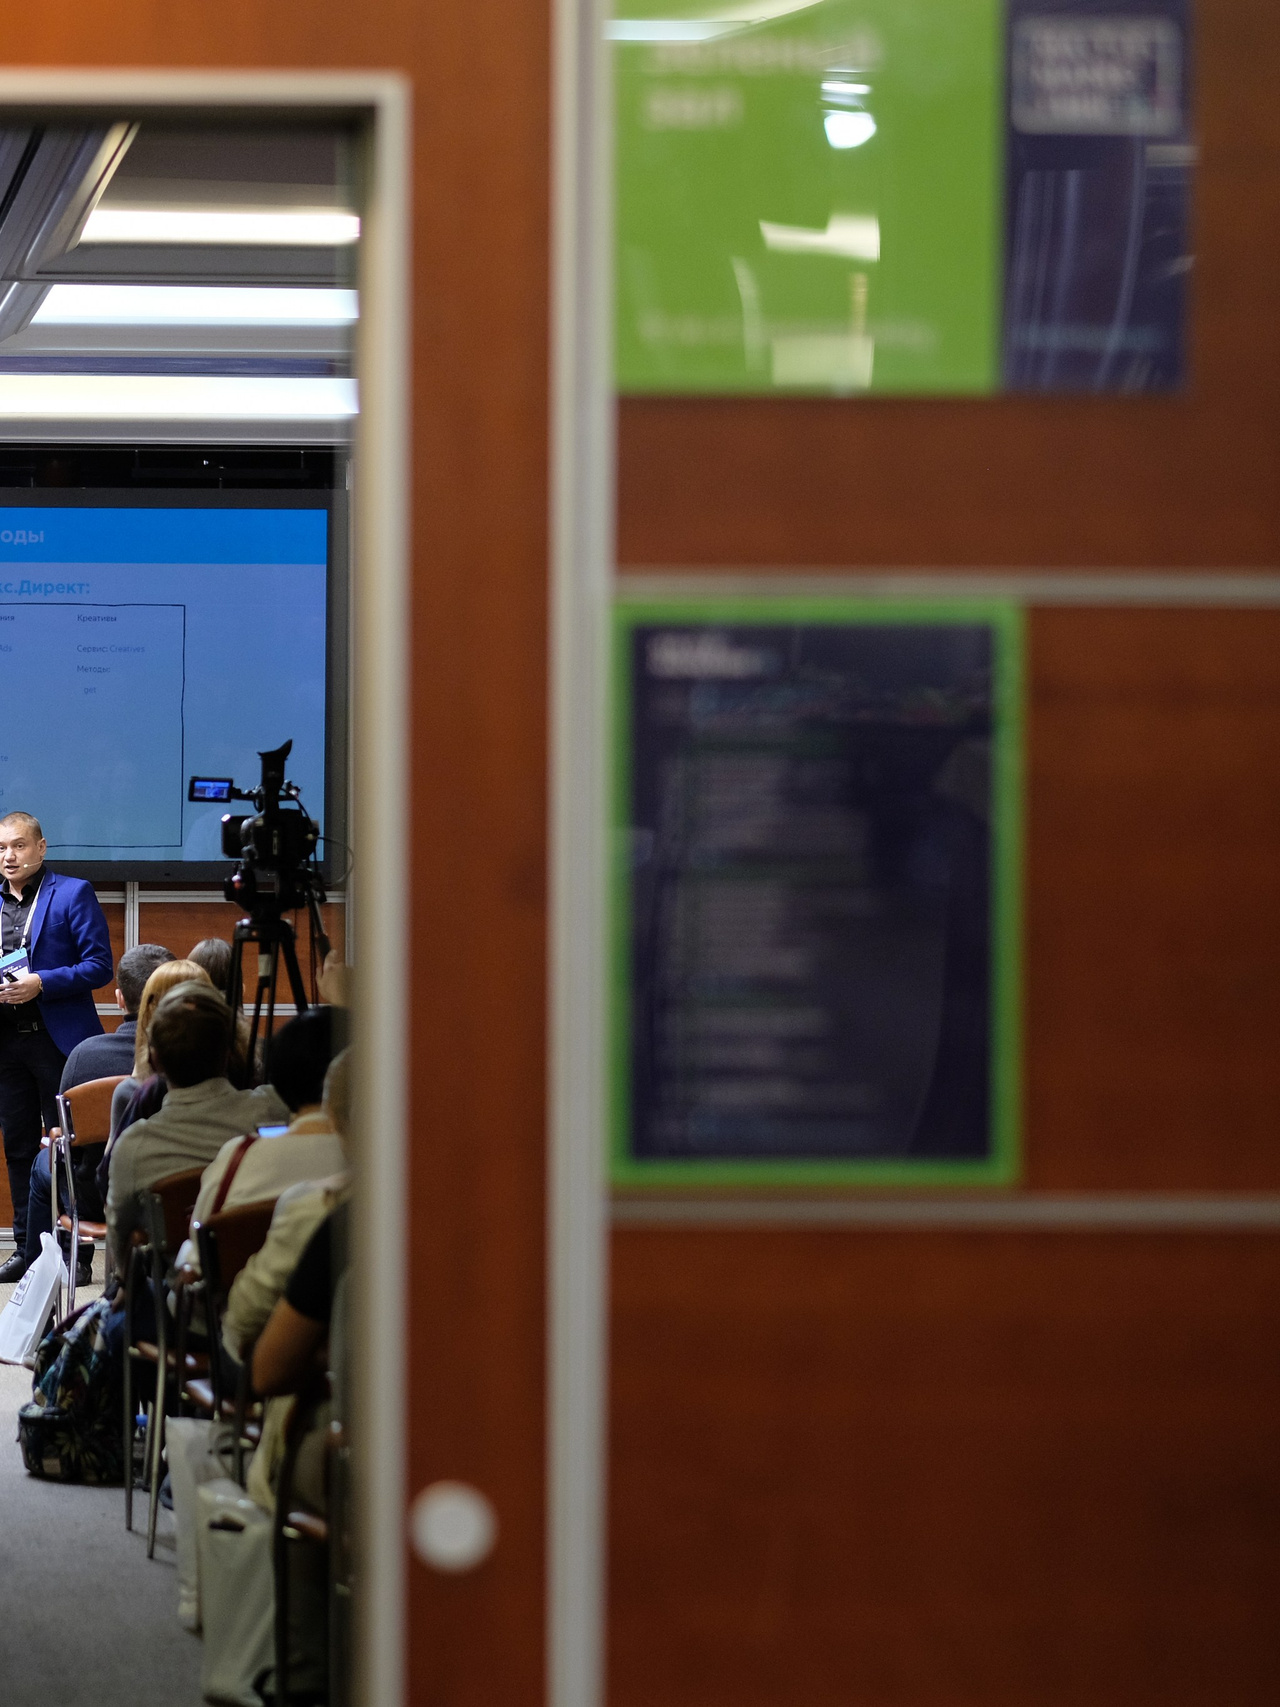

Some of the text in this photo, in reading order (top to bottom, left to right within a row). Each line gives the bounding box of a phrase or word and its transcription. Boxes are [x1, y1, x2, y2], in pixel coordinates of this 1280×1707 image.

[77, 614, 118, 623] Креативы
[76, 644, 146, 653] Сервис: Creatives
[76, 665, 111, 674] Методы:
[83, 686, 97, 694] get
